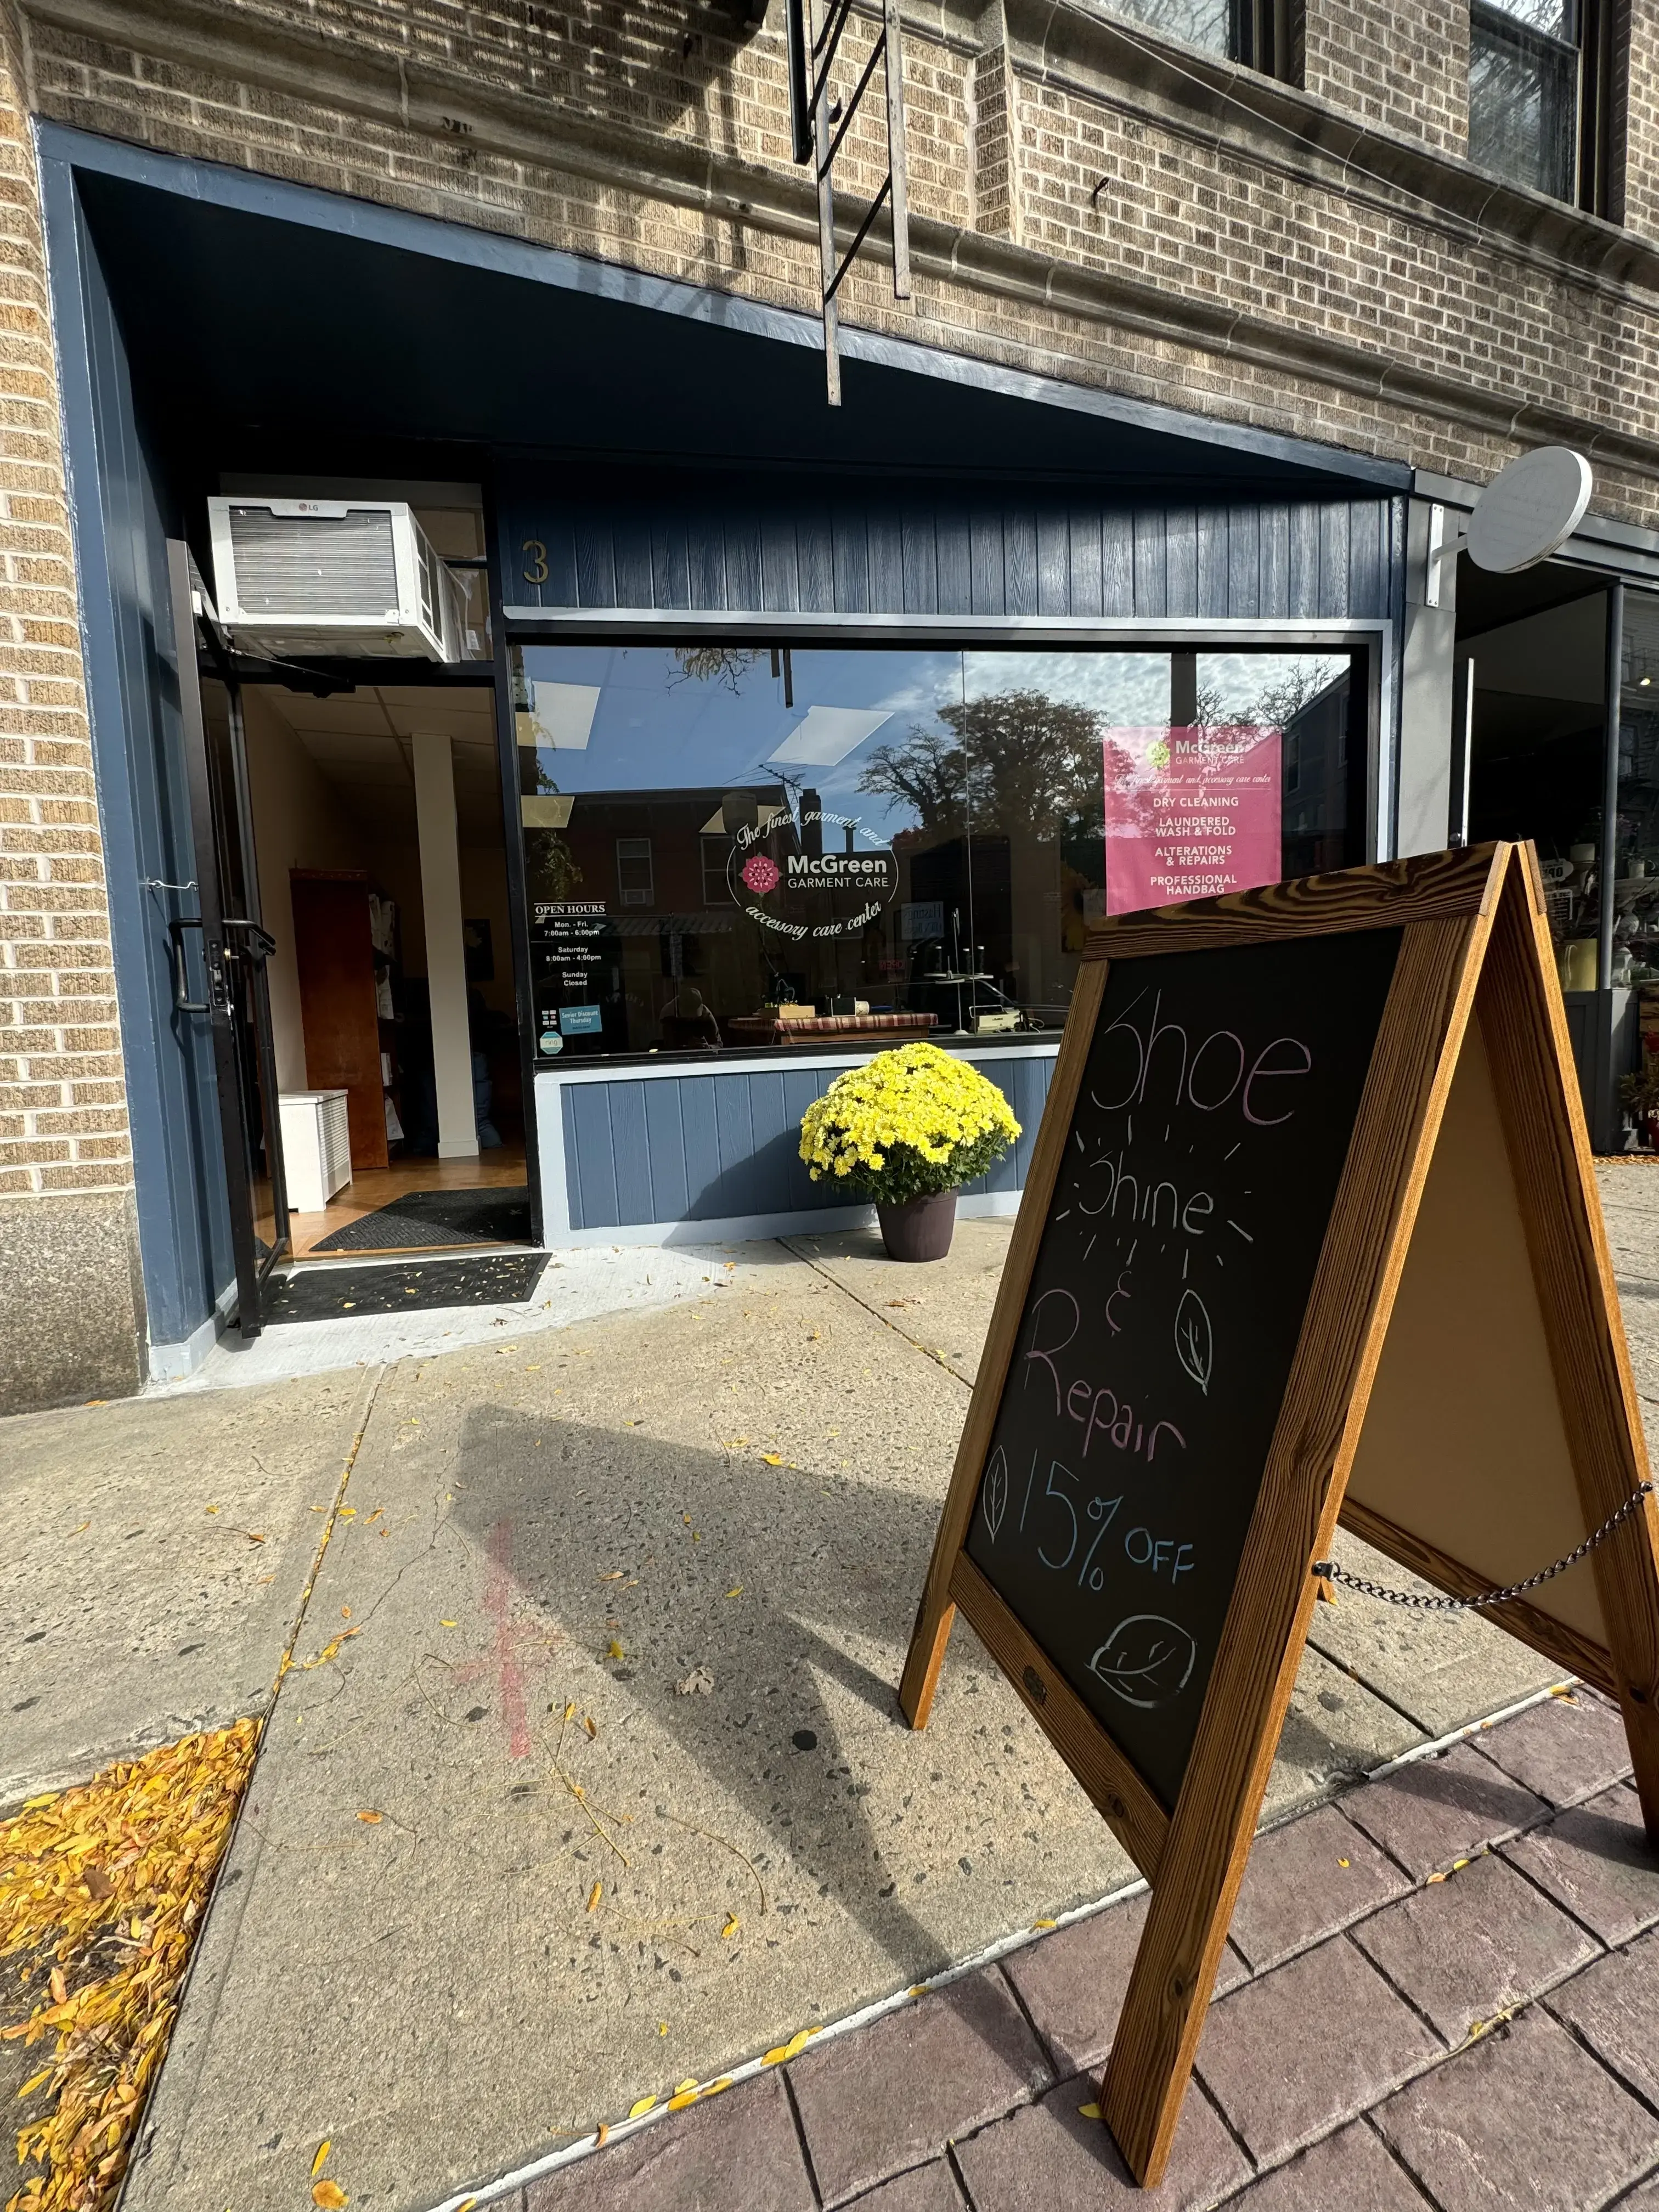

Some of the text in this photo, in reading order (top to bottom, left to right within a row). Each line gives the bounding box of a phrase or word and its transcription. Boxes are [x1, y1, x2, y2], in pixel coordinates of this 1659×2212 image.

[523, 540, 548, 583] 3
[1176, 741, 1244, 754] McGreen
[1176, 756, 1218, 765] GARMENT
[1153, 797, 1239, 808] DRY CLEANING
[1159, 816, 1229, 827] LAUNDERED
[737, 806, 889, 850] The finest garment and
[1155, 826, 1236, 837] WASH & FOLD
[1155, 845, 1232, 857] ALTERATIONS
[788, 855, 887, 874] McGreen
[1166, 856, 1225, 866] & REPAIRS
[788, 877, 889, 888] GARMENT CARE
[1150, 874, 1237, 886] PROFESSIONAL
[1166, 884, 1225, 895] HANDBAG
[535, 905, 605, 915] OPEN HOURS
[746, 906, 808, 941] accessory
[812, 922, 842, 938] care
[848, 901, 882, 930] center
[1091, 986, 1312, 1125] Shoe
[1079, 1150, 1214, 1235] Shine
[1024, 1289, 1186, 1462] Repair
[1020, 1449, 1194, 1591] 15% OFF
